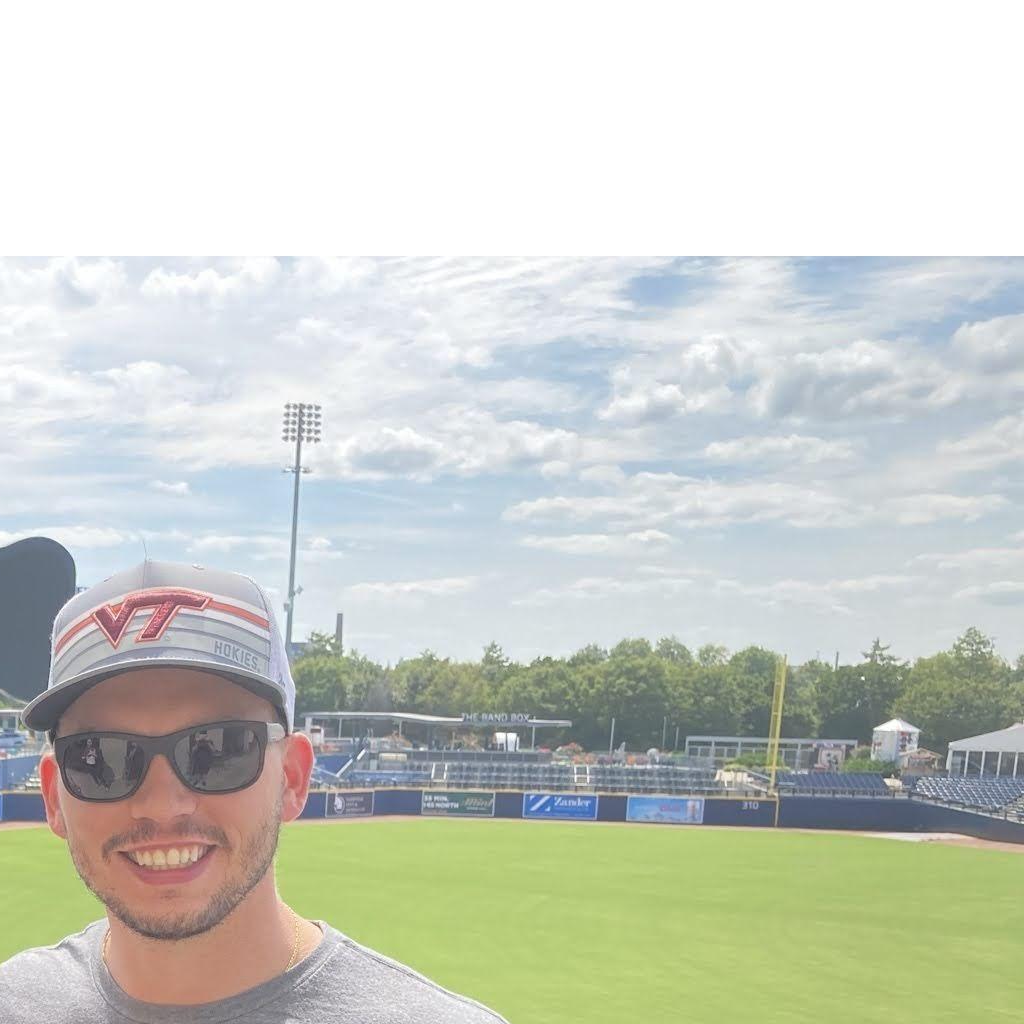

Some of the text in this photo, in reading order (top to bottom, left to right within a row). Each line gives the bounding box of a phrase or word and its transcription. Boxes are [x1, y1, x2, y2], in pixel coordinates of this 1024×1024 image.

[91, 587, 212, 649] VT
[214, 640, 259, 669] HOKIES
[461, 712, 530, 722] THE BAND BOX
[554, 796, 591, 808] Zander
[741, 801, 759, 810] 310
